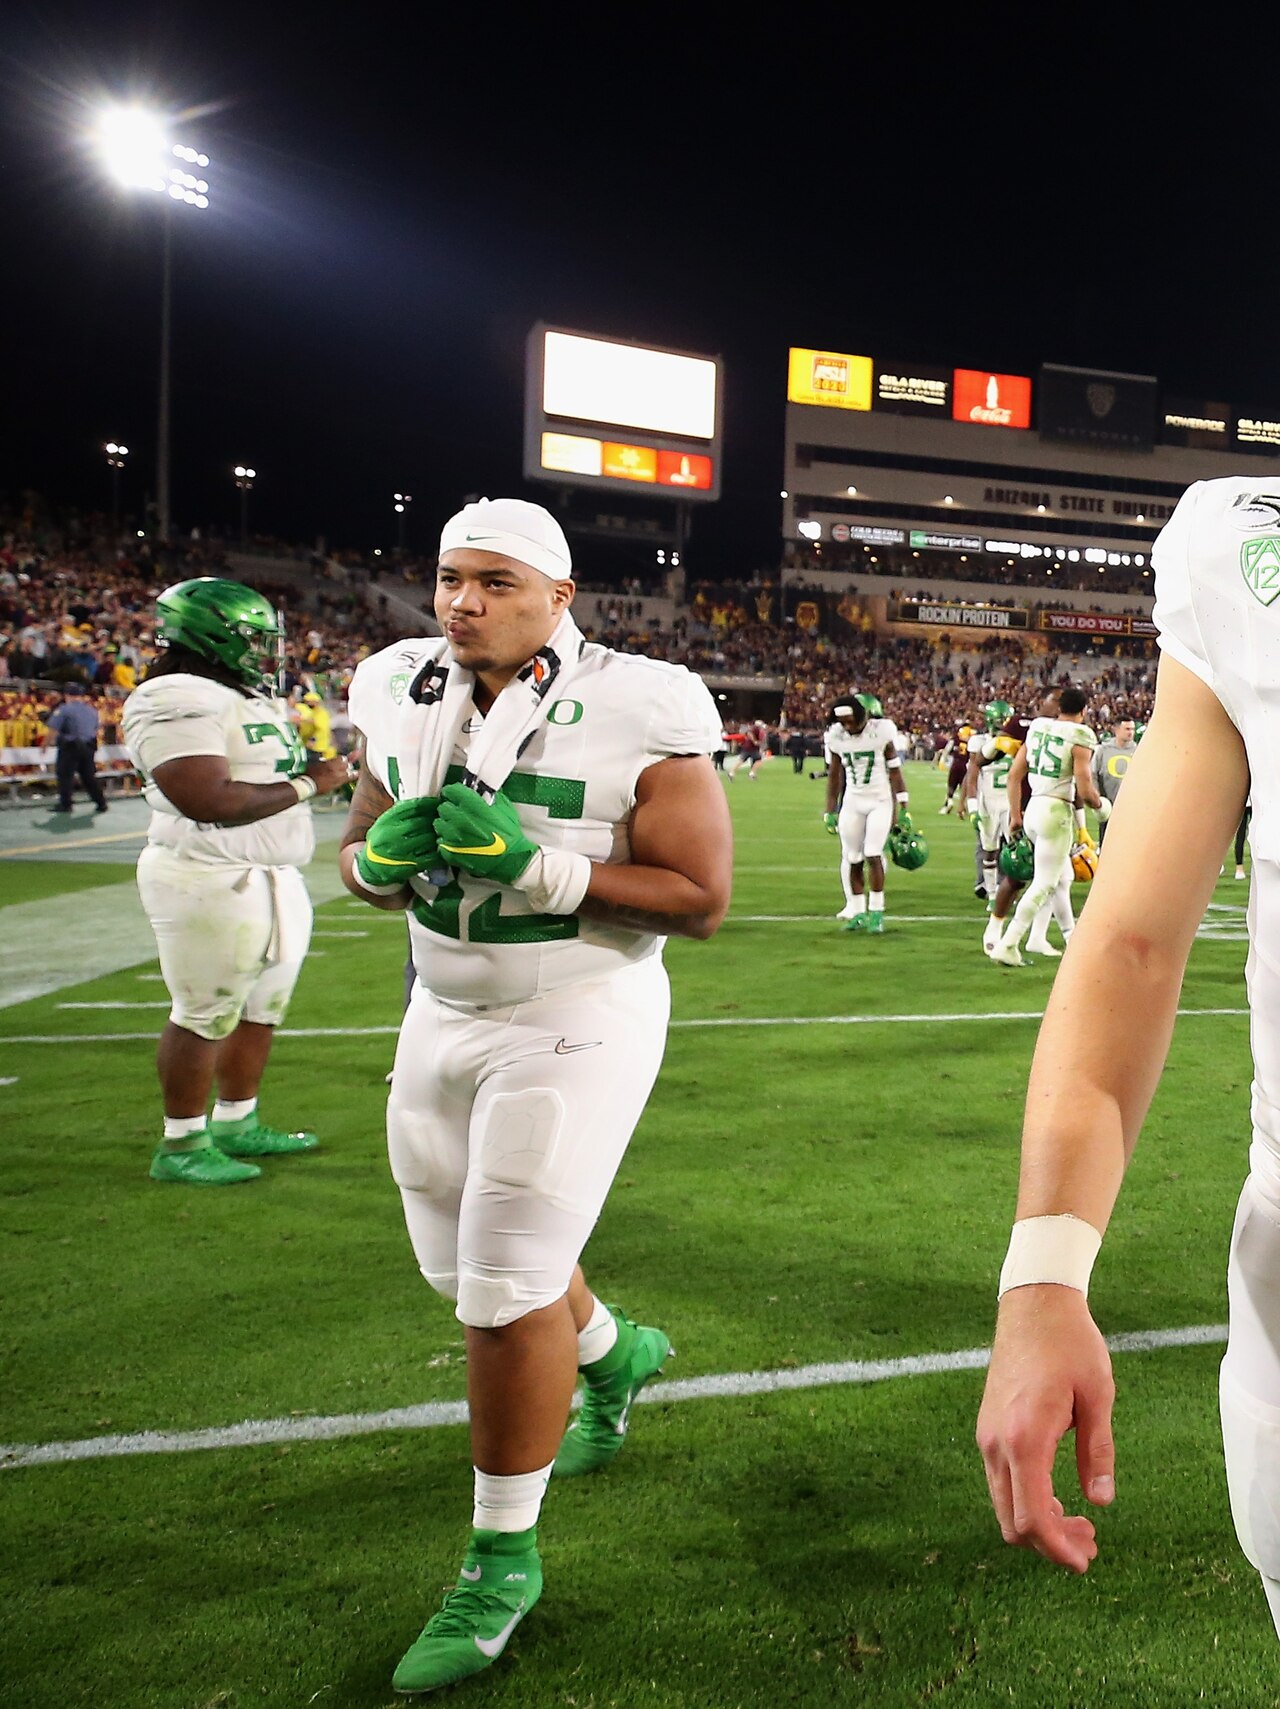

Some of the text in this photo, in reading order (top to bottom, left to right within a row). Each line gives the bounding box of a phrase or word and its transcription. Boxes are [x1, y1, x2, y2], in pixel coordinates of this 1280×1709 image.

[984, 487, 1050, 507] ARIZONA
[1059, 494, 1104, 513] STATE
[1254, 565, 1280, 590] 12
[962, 609, 1010, 627] PROTEIN
[1049, 614, 1075, 627] YOU
[1077, 616, 1096, 629] DO
[1099, 618, 1123, 631] YOU
[547, 699, 584, 725] O
[842, 750, 875, 785] 17
[1027, 730, 1064, 779] 35
